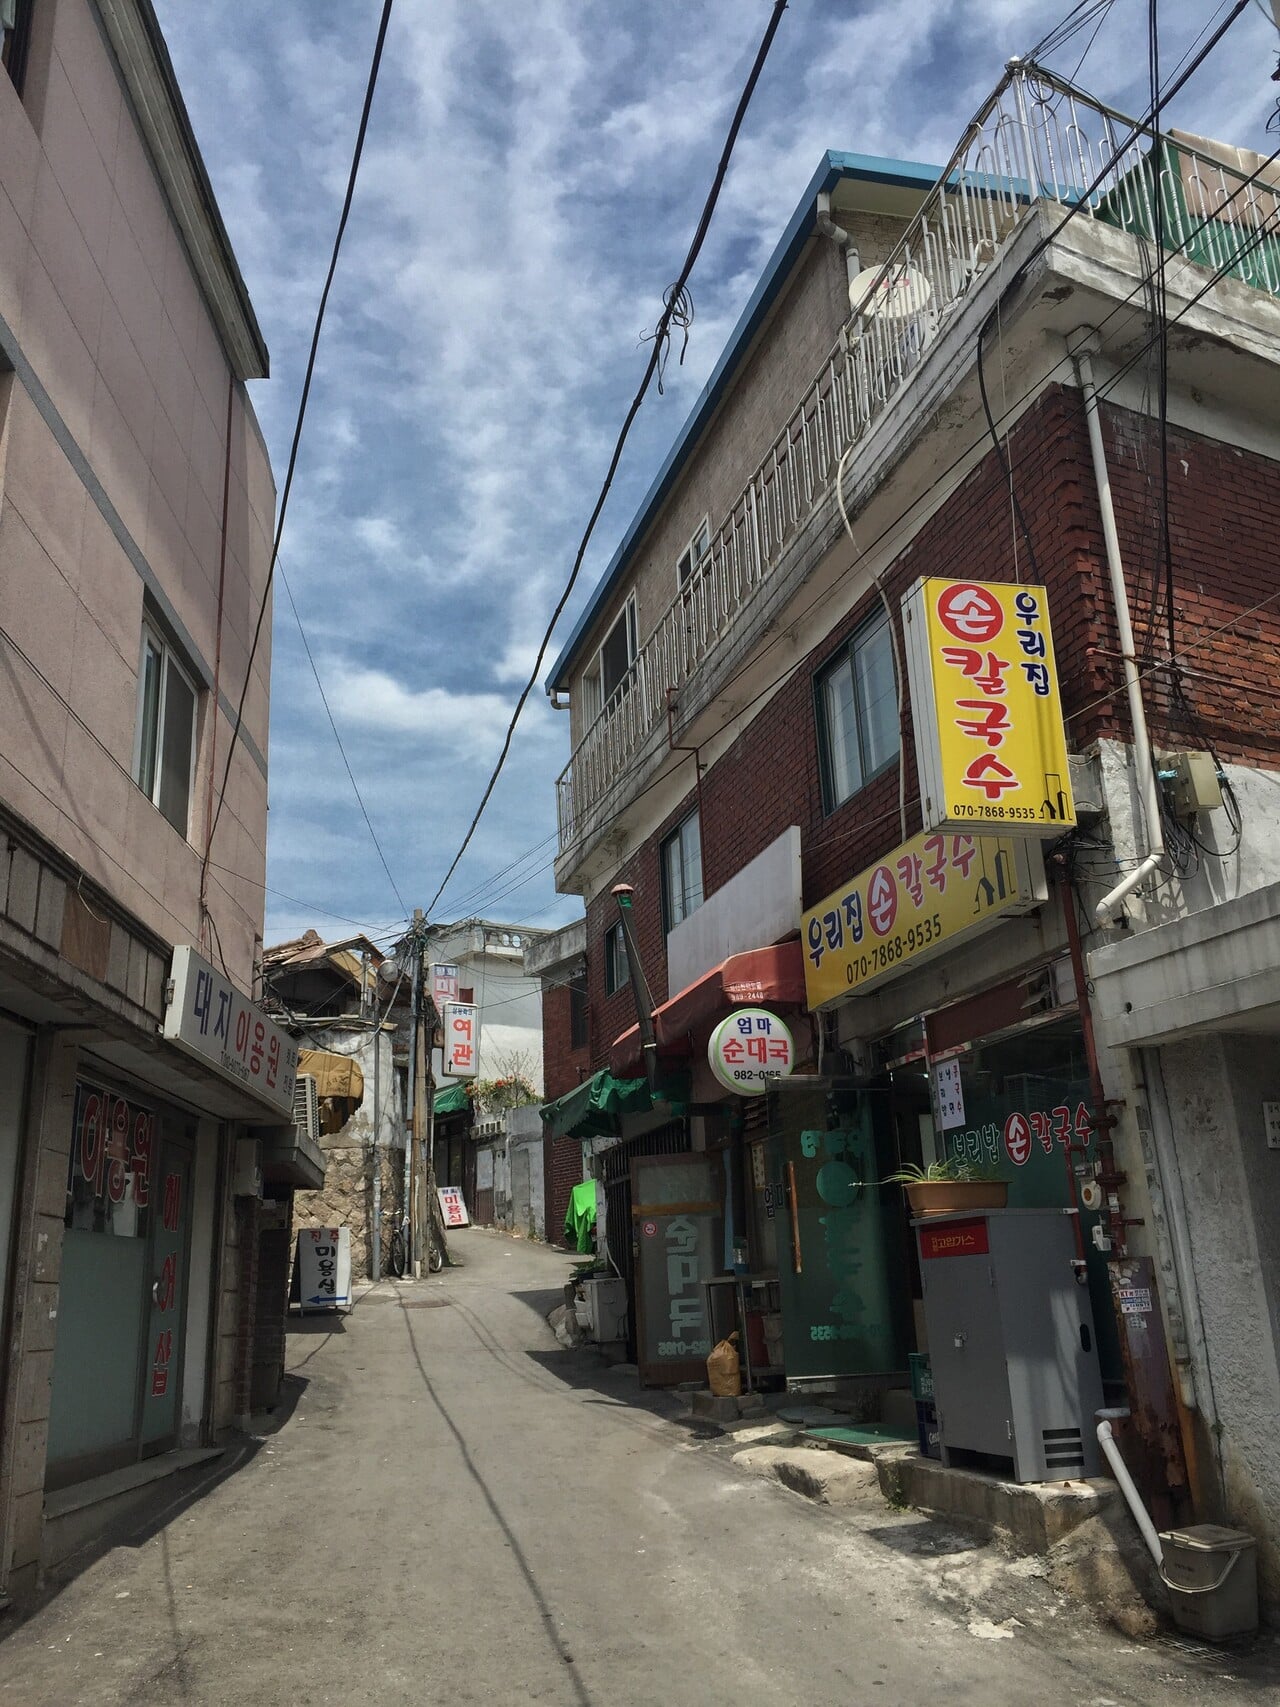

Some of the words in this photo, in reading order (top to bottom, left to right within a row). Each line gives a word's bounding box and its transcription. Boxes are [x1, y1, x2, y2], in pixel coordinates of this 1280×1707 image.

[1015, 592, 1050, 696] 우리집
[939, 585, 1020, 799] 손칼국수
[953, 804, 1036, 820] 070-7868-9535
[808, 890, 863, 967] 우리집
[868, 835, 976, 935] 손칼국수
[846, 913, 942, 985] 070-7868-9535
[193, 968, 233, 1051] 대지
[235, 1010, 281, 1089] 이용원
[452, 1018, 473, 1067] 여관
[722, 1037, 789, 1065] 순대국
[737, 1017, 772, 1035] 엄마
[1004, 1101, 1094, 1165] 손칼국수
[445, 1194, 462, 1223] 미용실
[315, 1245, 336, 1294] 미용실
